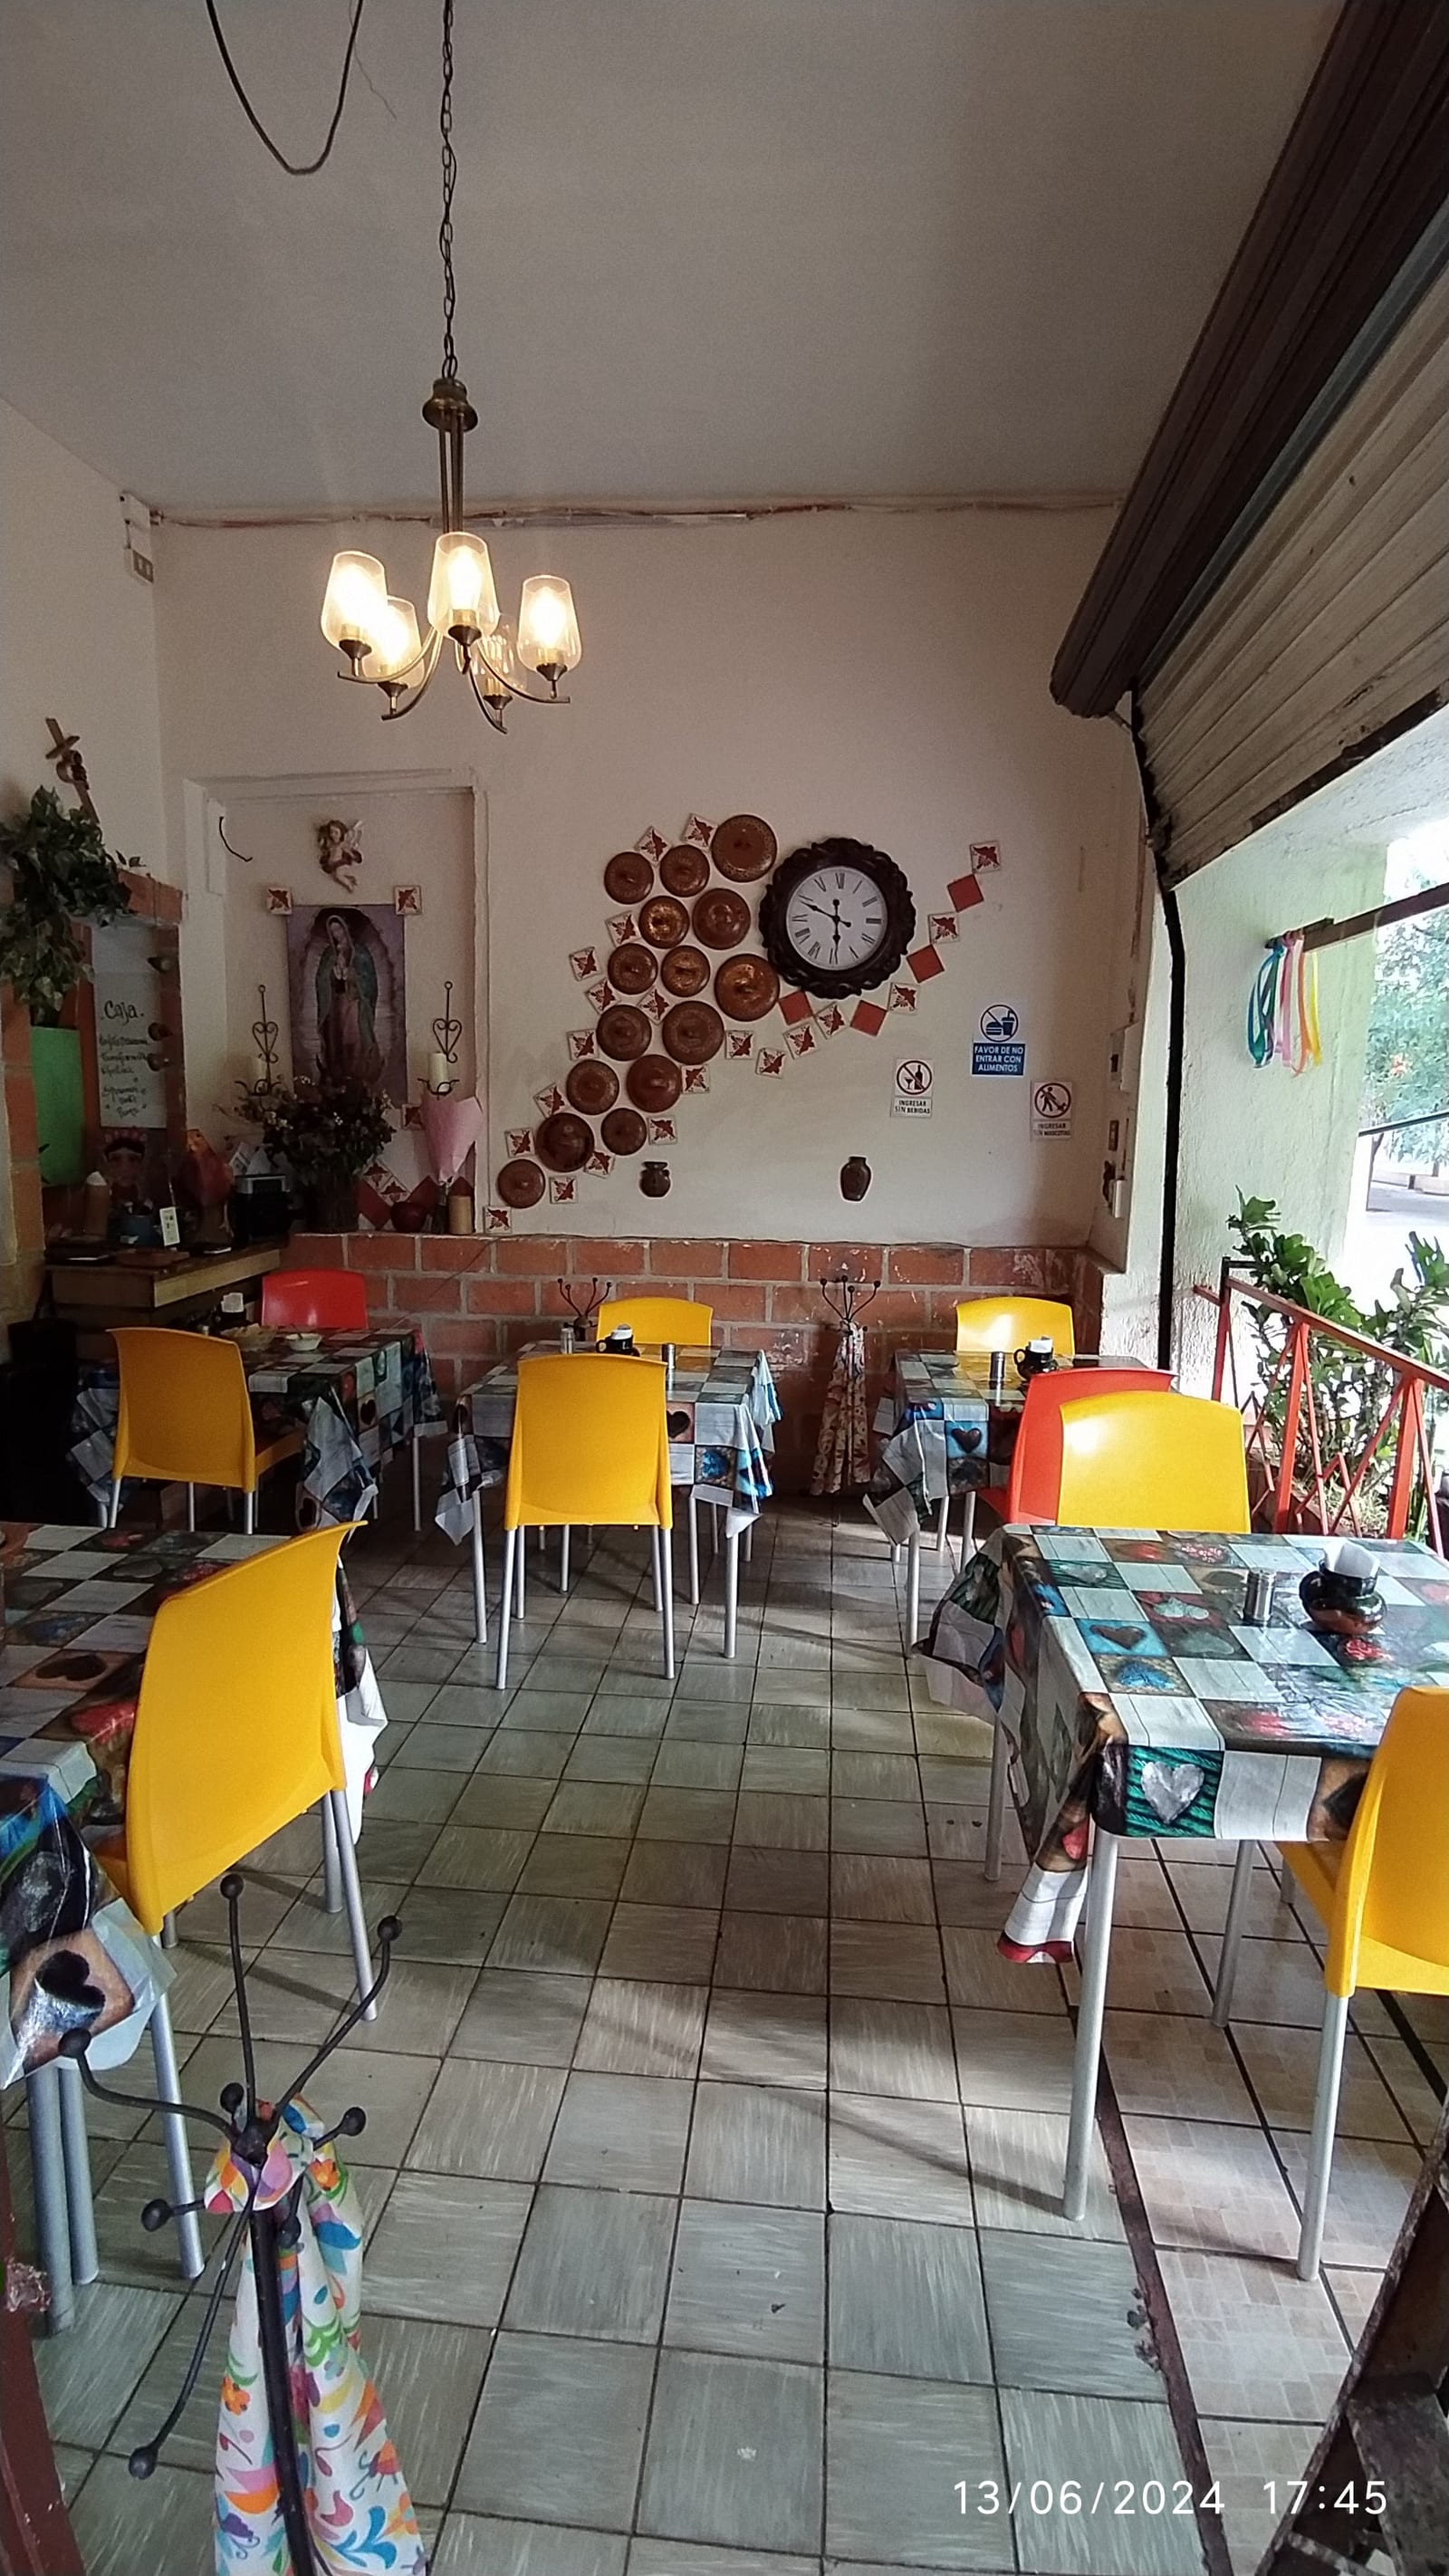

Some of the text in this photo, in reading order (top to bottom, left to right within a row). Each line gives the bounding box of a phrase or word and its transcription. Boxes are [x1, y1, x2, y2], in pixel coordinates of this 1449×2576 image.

[974, 1045, 1024, 1055] FAVOR DE NO
[975, 1054, 1022, 1063] ENTRAR CON
[978, 1063, 1018, 1072] ALIMENTOS
[895, 1105, 906, 1113] SIN
